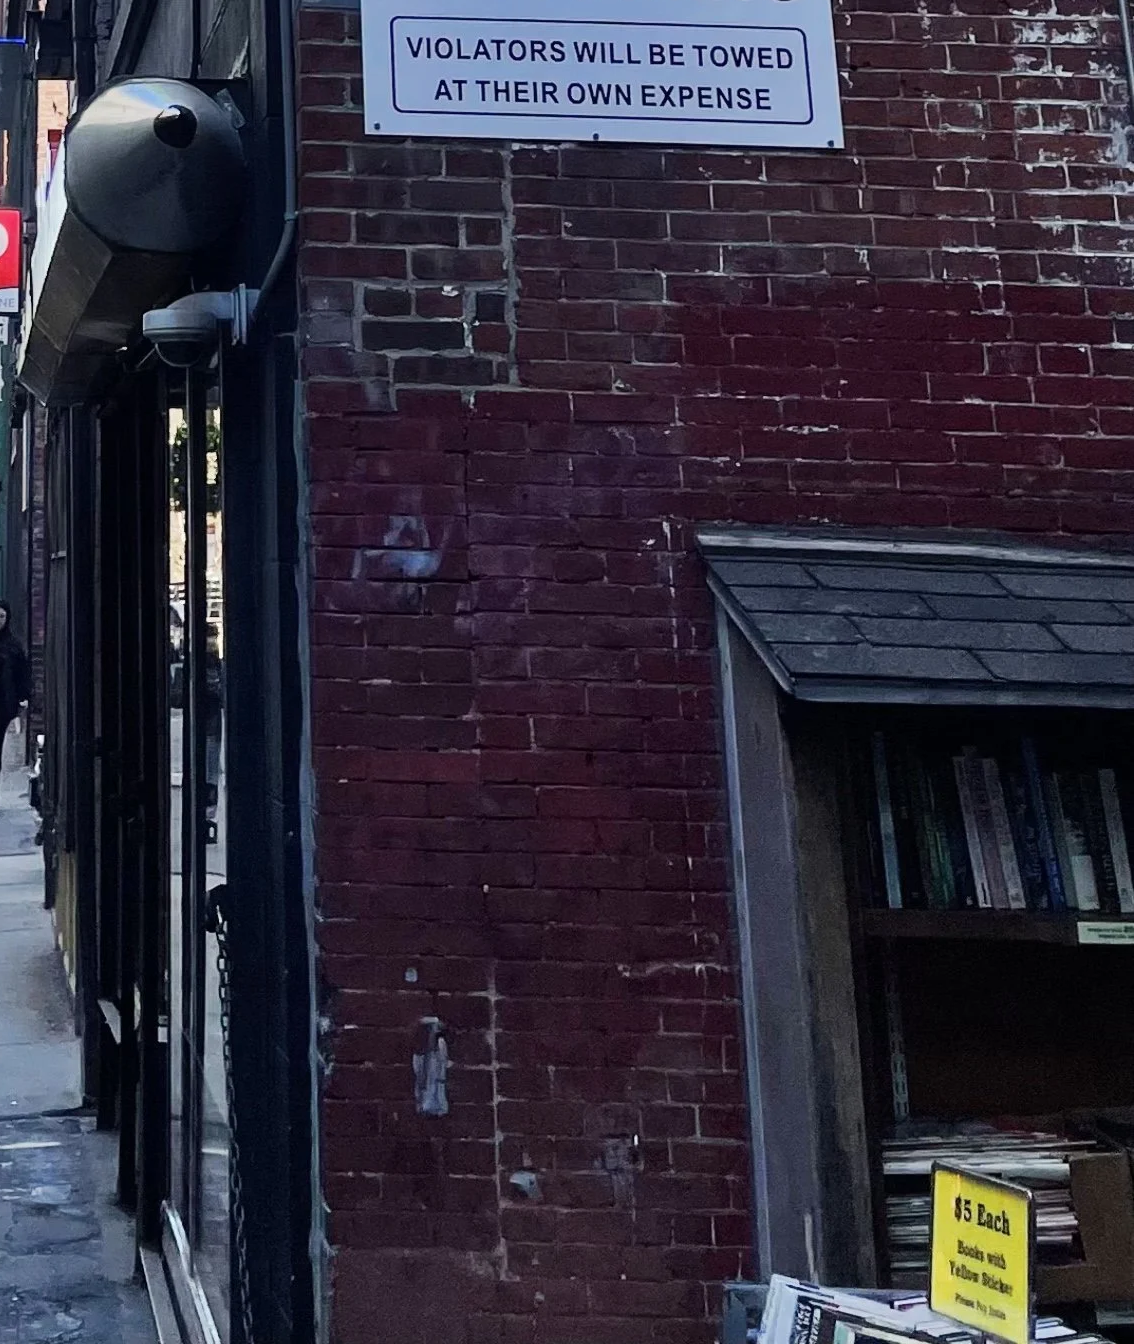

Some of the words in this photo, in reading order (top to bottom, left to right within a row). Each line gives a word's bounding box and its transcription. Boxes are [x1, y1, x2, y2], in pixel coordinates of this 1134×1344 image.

[406, 37, 566, 63] VIOLATORS
[572, 41, 641, 65] WILL
[649, 44, 686, 67] BE
[691, 46, 794, 70] TOWED
[434, 79, 467, 102] AT
[475, 80, 560, 105] THEIR
[566, 83, 632, 107] OWN
[641, 86, 772, 111] EXPENSE
[954, 1194, 972, 1223] $5
[977, 1203, 1011, 1236] Each
[957, 1240, 984, 1263] Books
[987, 1251, 1007, 1270] with
[949, 1260, 979, 1283] Yellow
[981, 1272, 1013, 1297] Sticker
